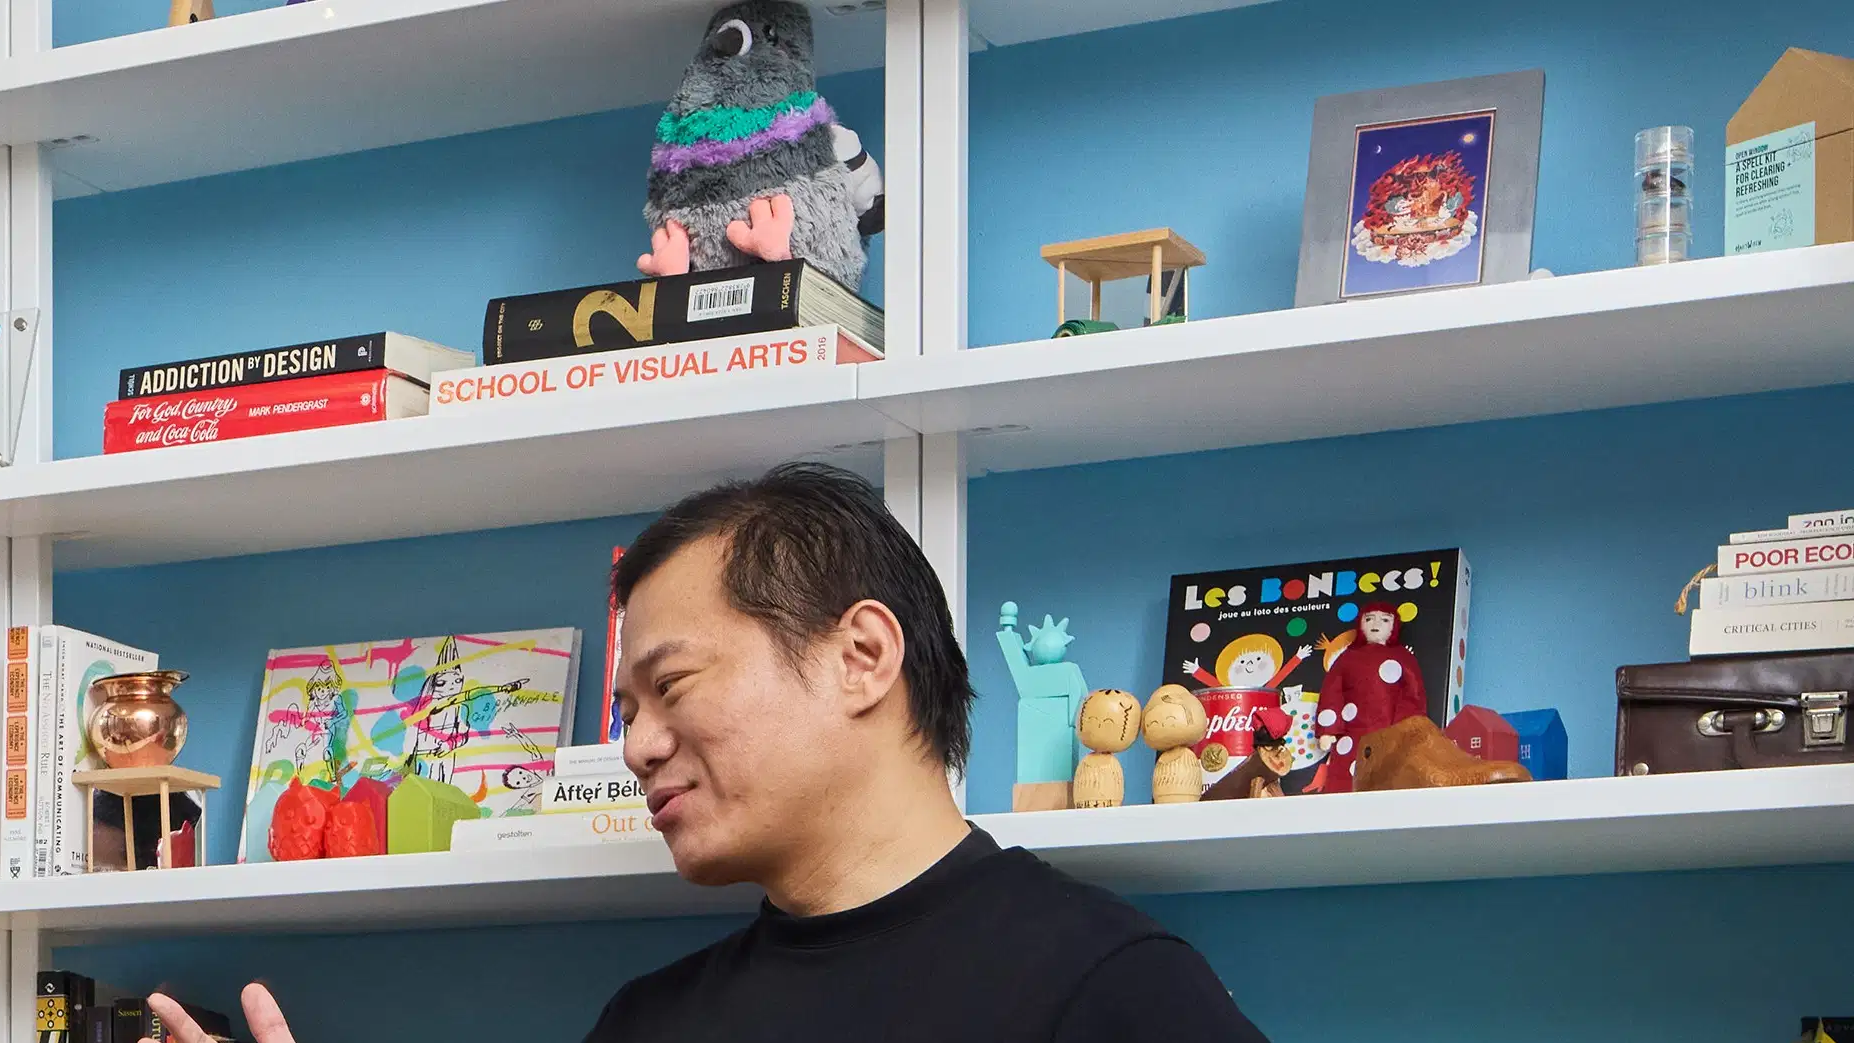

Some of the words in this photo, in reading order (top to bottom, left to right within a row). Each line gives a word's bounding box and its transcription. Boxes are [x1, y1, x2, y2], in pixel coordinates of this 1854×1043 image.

[1735, 161, 1741, 173] A
[1742, 154, 1763, 171] SPELL
[1765, 151, 1777, 165] KIT
[1735, 171, 1750, 185] FOR
[1750, 161, 1786, 181] CLEARING
[1735, 176, 1780, 198] REFRESHING
[780, 272, 792, 312] TASCHEN
[816, 335, 827, 362] 2016
[139, 357, 244, 395] ADDICTION
[247, 355, 261, 370] BY
[263, 344, 337, 378] DESIGN
[437, 370, 558, 406] SCHOOL
[565, 362, 606, 391] OF
[613, 350, 718, 385] VISUAL
[726, 338, 809, 372] ARTS
[128, 402, 152, 425] For
[181, 397, 238, 418] Country
[249, 405, 271, 418] MARK
[272, 398, 328, 415] PENDERGRAST
[135, 424, 161, 445] and
[1734, 548, 1799, 569] POOR
[1744, 577, 1809, 600] blink
[1217, 609, 1240, 621] joue
[1240, 609, 1252, 618] au
[1253, 606, 1272, 617] loto
[1273, 604, 1290, 615] des
[1291, 601, 1331, 613] couleurs
[1723, 623, 1777, 635] CRITICAL
[1780, 620, 1818, 631] CITIES
[86, 640, 113, 655] NATIONAL
[113, 648, 145, 663] BESTSELLER
[57, 755, 64, 767] OF
[55, 771, 63, 854] COMMUNICATING
[591, 812, 636, 835] Out
[496, 827, 533, 841] gestalten
[117, 1009, 143, 1018] Sassen
